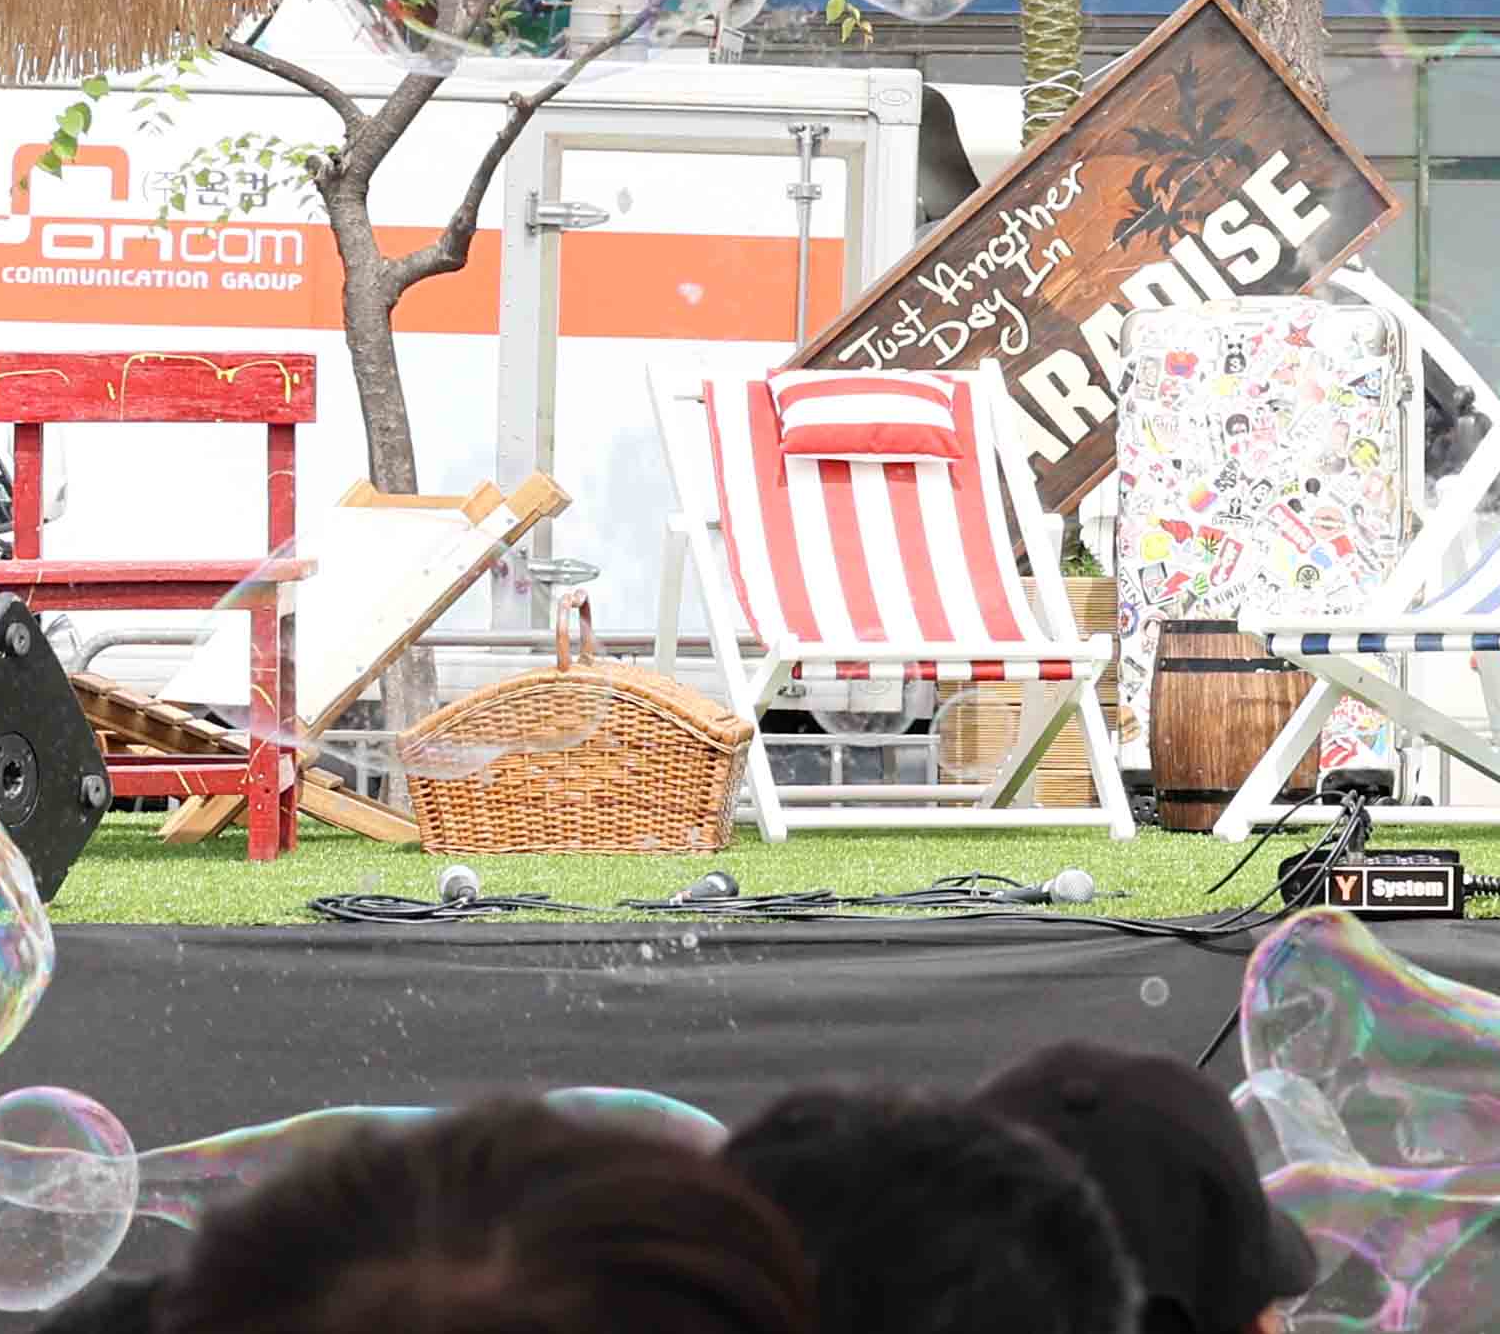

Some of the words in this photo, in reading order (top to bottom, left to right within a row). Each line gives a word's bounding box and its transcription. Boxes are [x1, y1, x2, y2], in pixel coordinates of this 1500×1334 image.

[1, 265, 209, 289] COMMUNICATION
[220, 271, 303, 292] GROUP
[837, 299, 927, 370] Just
[916, 161, 1084, 306] Another
[918, 287, 1030, 367] Day
[1003, 237, 1074, 298] In
[1010, 150, 1332, 465] ARADISE
[1334, 874, 1359, 901] Y
[1371, 878, 1444, 902] System
